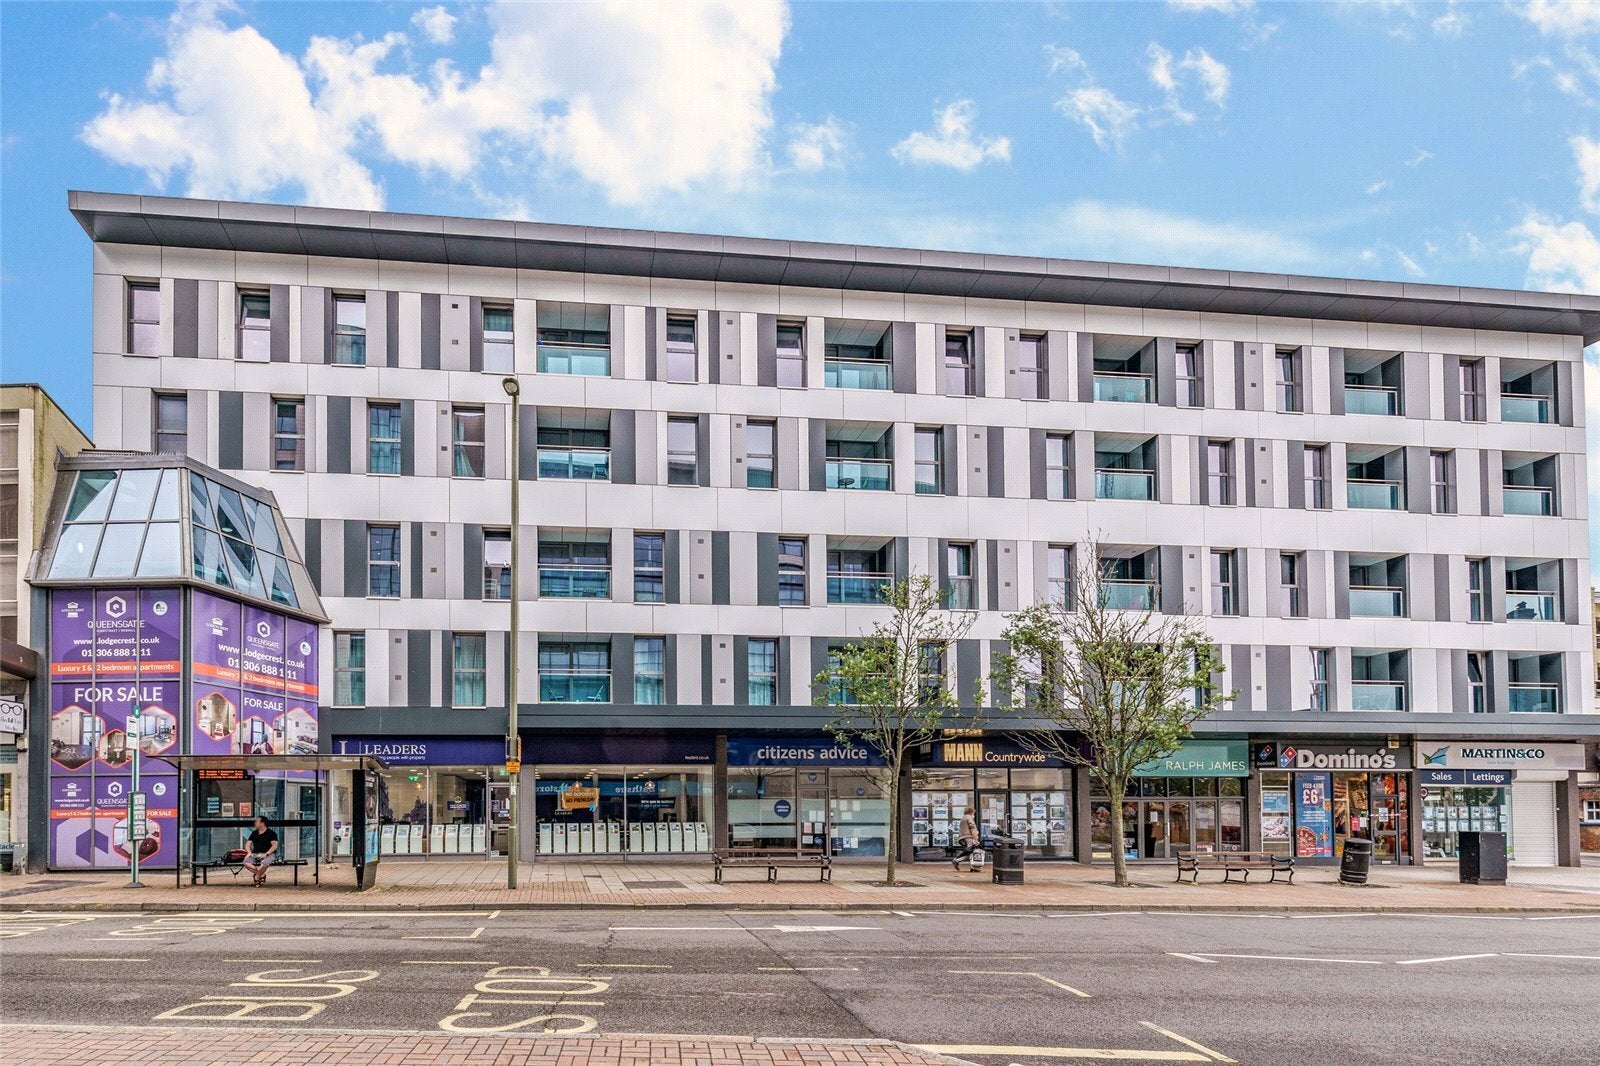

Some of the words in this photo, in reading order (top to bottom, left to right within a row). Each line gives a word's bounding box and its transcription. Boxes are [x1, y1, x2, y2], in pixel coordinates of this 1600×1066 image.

[88, 620, 145, 628] QUEENSGATE
[247, 635, 280, 648] QUEENSGATE
[216, 668, 236, 679] Luxury
[262, 665, 278, 676] 888
[75, 687, 114, 702] FOR
[117, 686, 162, 702] SALE
[244, 697, 262, 708] FOR
[264, 700, 284, 712] SALE
[364, 744, 426, 754] LEADERS
[758, 746, 814, 760] citizens
[820, 746, 868, 760] advice
[944, 744, 982, 762] MANN
[985, 752, 1046, 764] Countrywide
[1462, 748, 1544, 758] MARTIN&CO
[1298, 748, 1396, 768] Domino's
[1166, 761, 1204, 770] RALPH
[1208, 761, 1246, 770] JAMES
[1432, 772, 1452, 780] Sales
[1472, 773, 1504, 782] Lettings
[1303, 789, 1318, 804] £6
[153, 968, 380, 1021] BUS
[438, 966, 612, 1034] STOP
